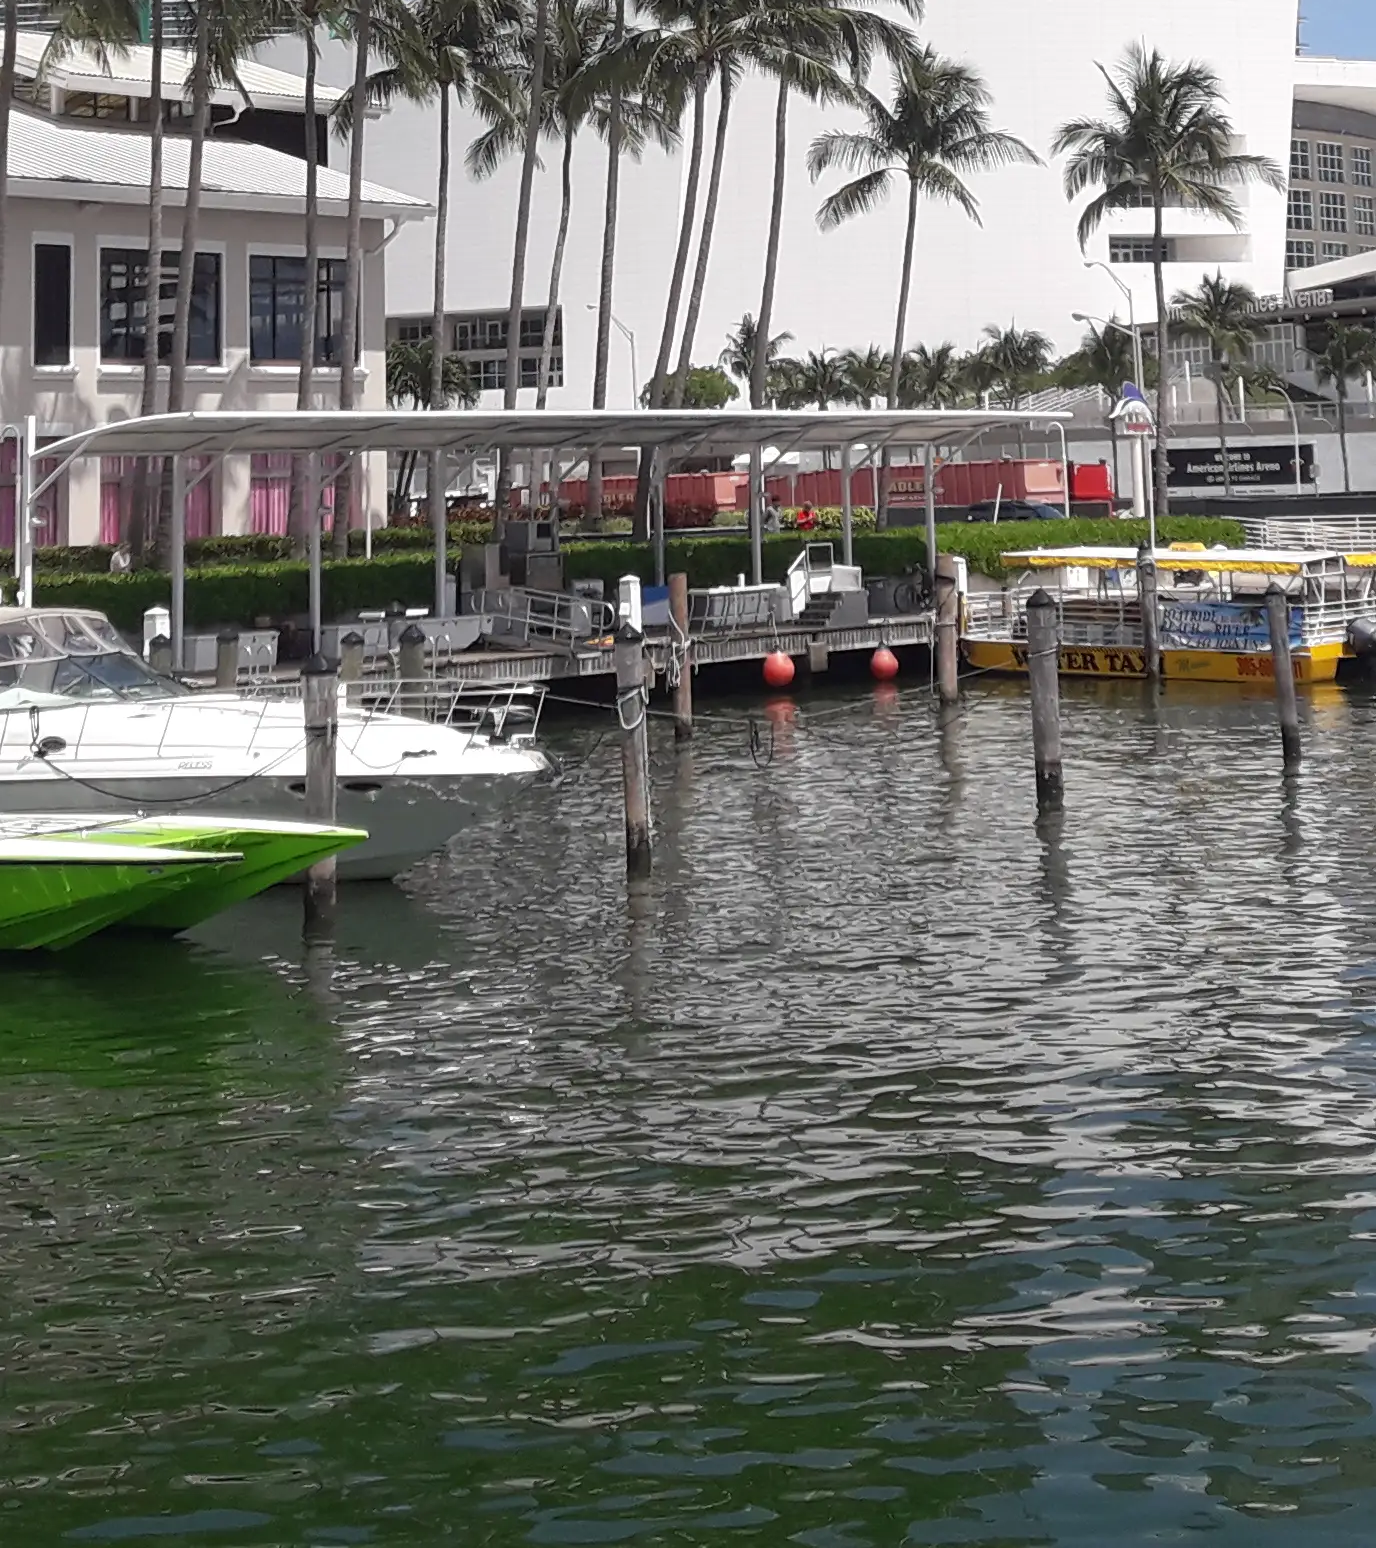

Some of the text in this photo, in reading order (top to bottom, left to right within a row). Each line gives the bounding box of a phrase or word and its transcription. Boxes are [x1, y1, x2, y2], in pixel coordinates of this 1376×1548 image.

[1186, 461, 1281, 473] American irlines Arena
[1008, 643, 1101, 672] WTER
